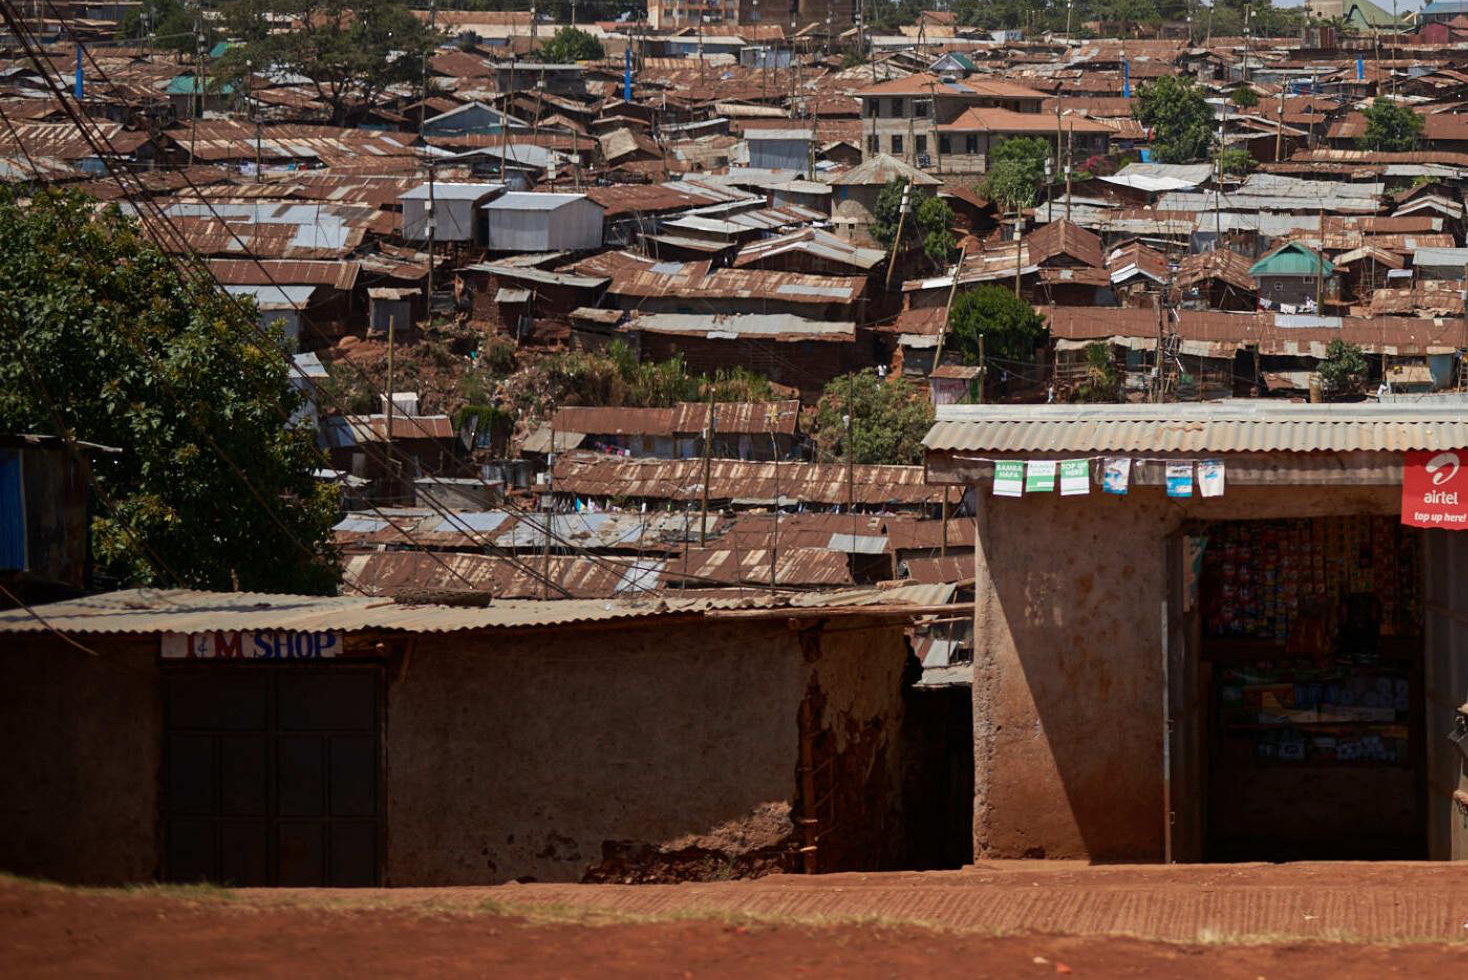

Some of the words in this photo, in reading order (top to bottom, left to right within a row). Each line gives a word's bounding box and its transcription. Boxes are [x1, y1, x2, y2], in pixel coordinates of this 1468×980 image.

[1424, 490, 1458, 504] airtel
[1414, 511, 1430, 523] top
[1431, 514, 1443, 524] up
[1443, 512, 1467, 523] here!
[254, 630, 336, 658] SHOP
